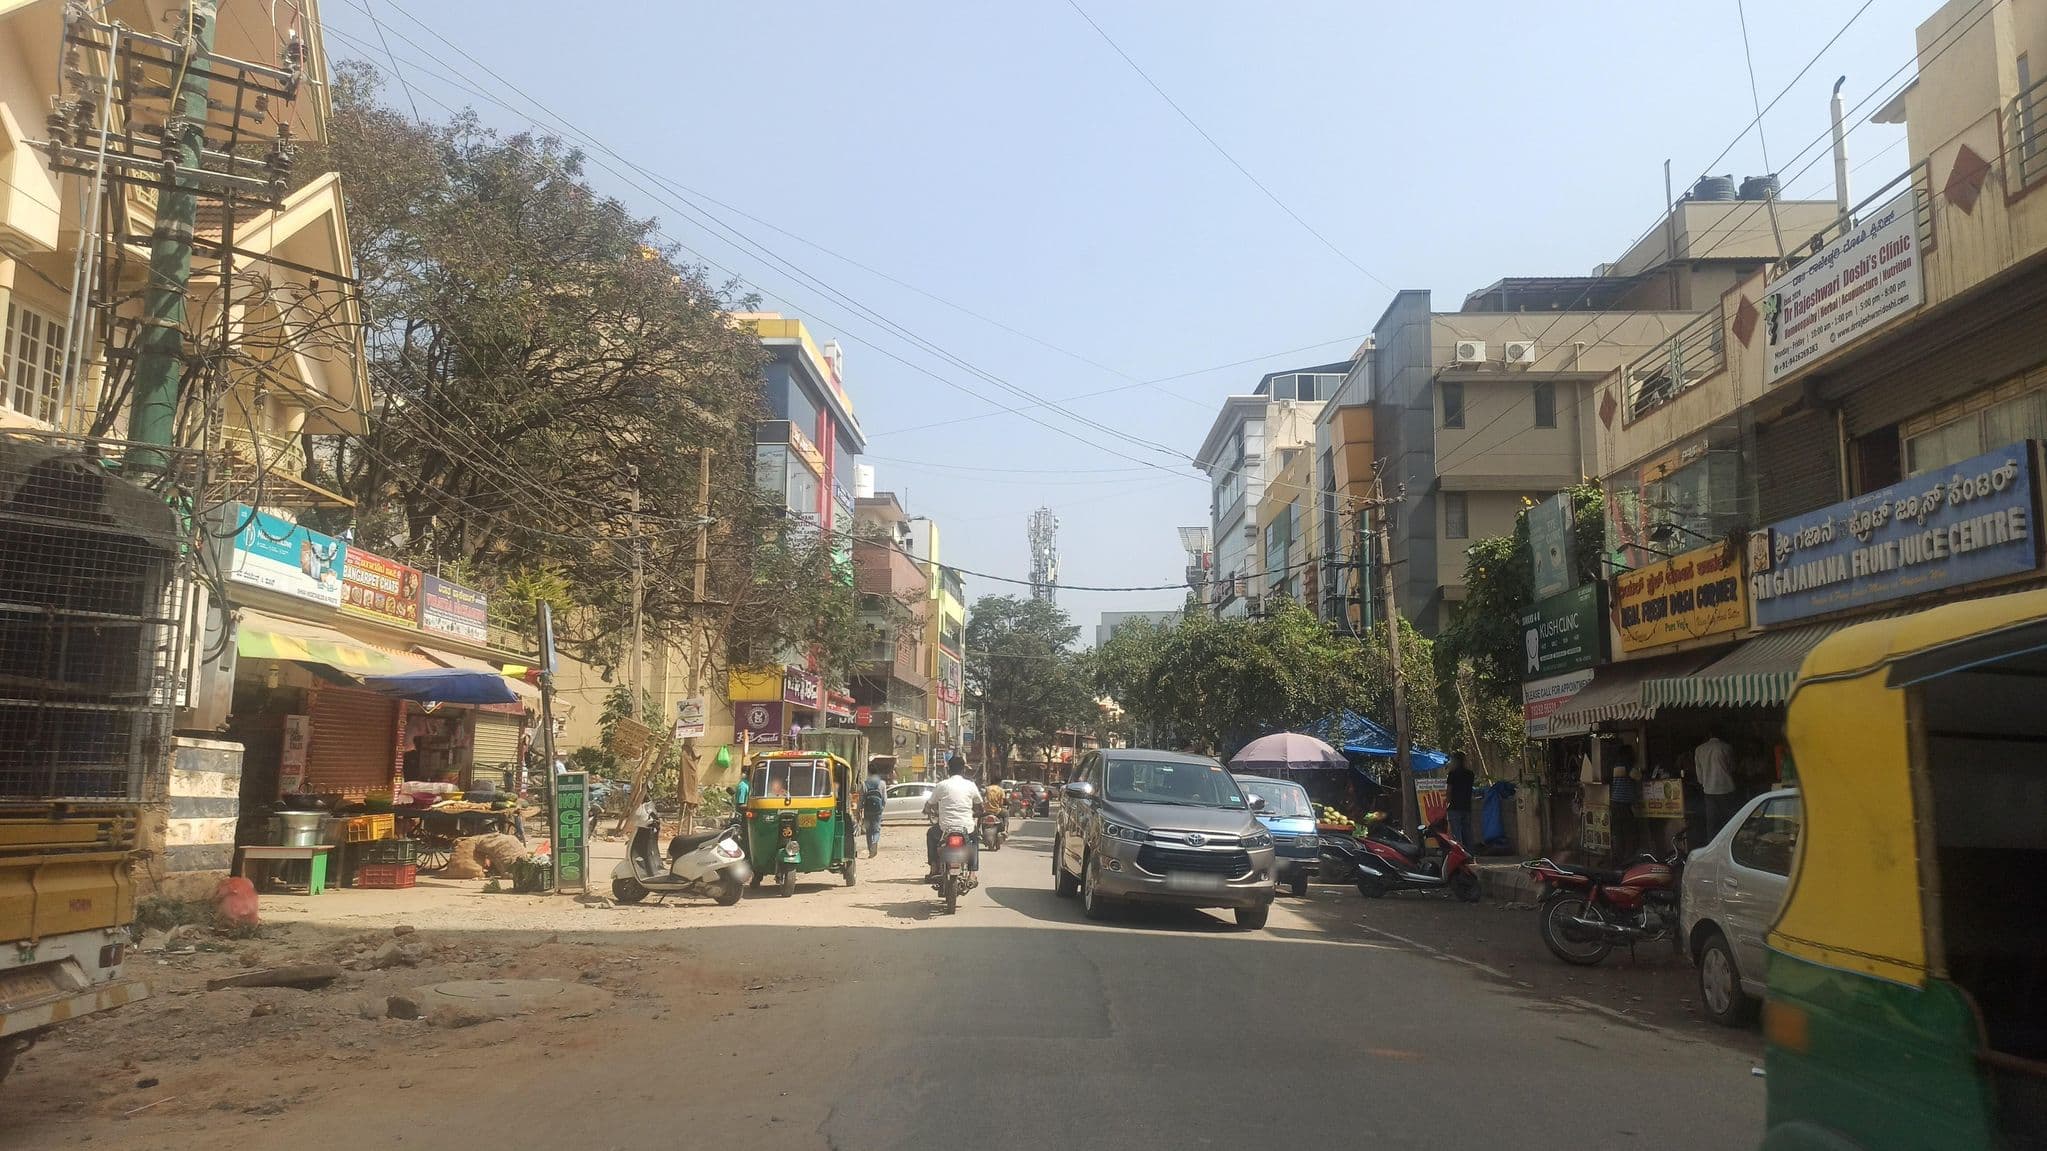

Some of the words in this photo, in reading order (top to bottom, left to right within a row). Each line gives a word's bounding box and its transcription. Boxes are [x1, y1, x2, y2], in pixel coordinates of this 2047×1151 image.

[1784, 306, 1793, 324] Dr
[1794, 274, 1841, 321] Rajeshwari
[1843, 254, 1877, 289] Doshi's
[1879, 234, 1911, 265] Clinic
[1820, 298, 1838, 321] Herbal
[1841, 276, 1879, 306] Acupuncture
[1882, 256, 1912, 282] Nutrition
[1751, 573, 1773, 600] SRI
[1773, 554, 1848, 596] GAJANANA
[1852, 541, 1899, 578] FRUIT
[1899, 527, 1949, 567] JUICE
[1949, 506, 2028, 555] CENTRE
[380, 577, 399, 595] CHATS
[1696, 576, 1738, 608] CORNER
[1540, 620, 1559, 640] KUSH
[1559, 613, 1579, 633] CLINIC
[559, 793, 582, 808] HOT
[560, 810, 581, 881] CHIPS
